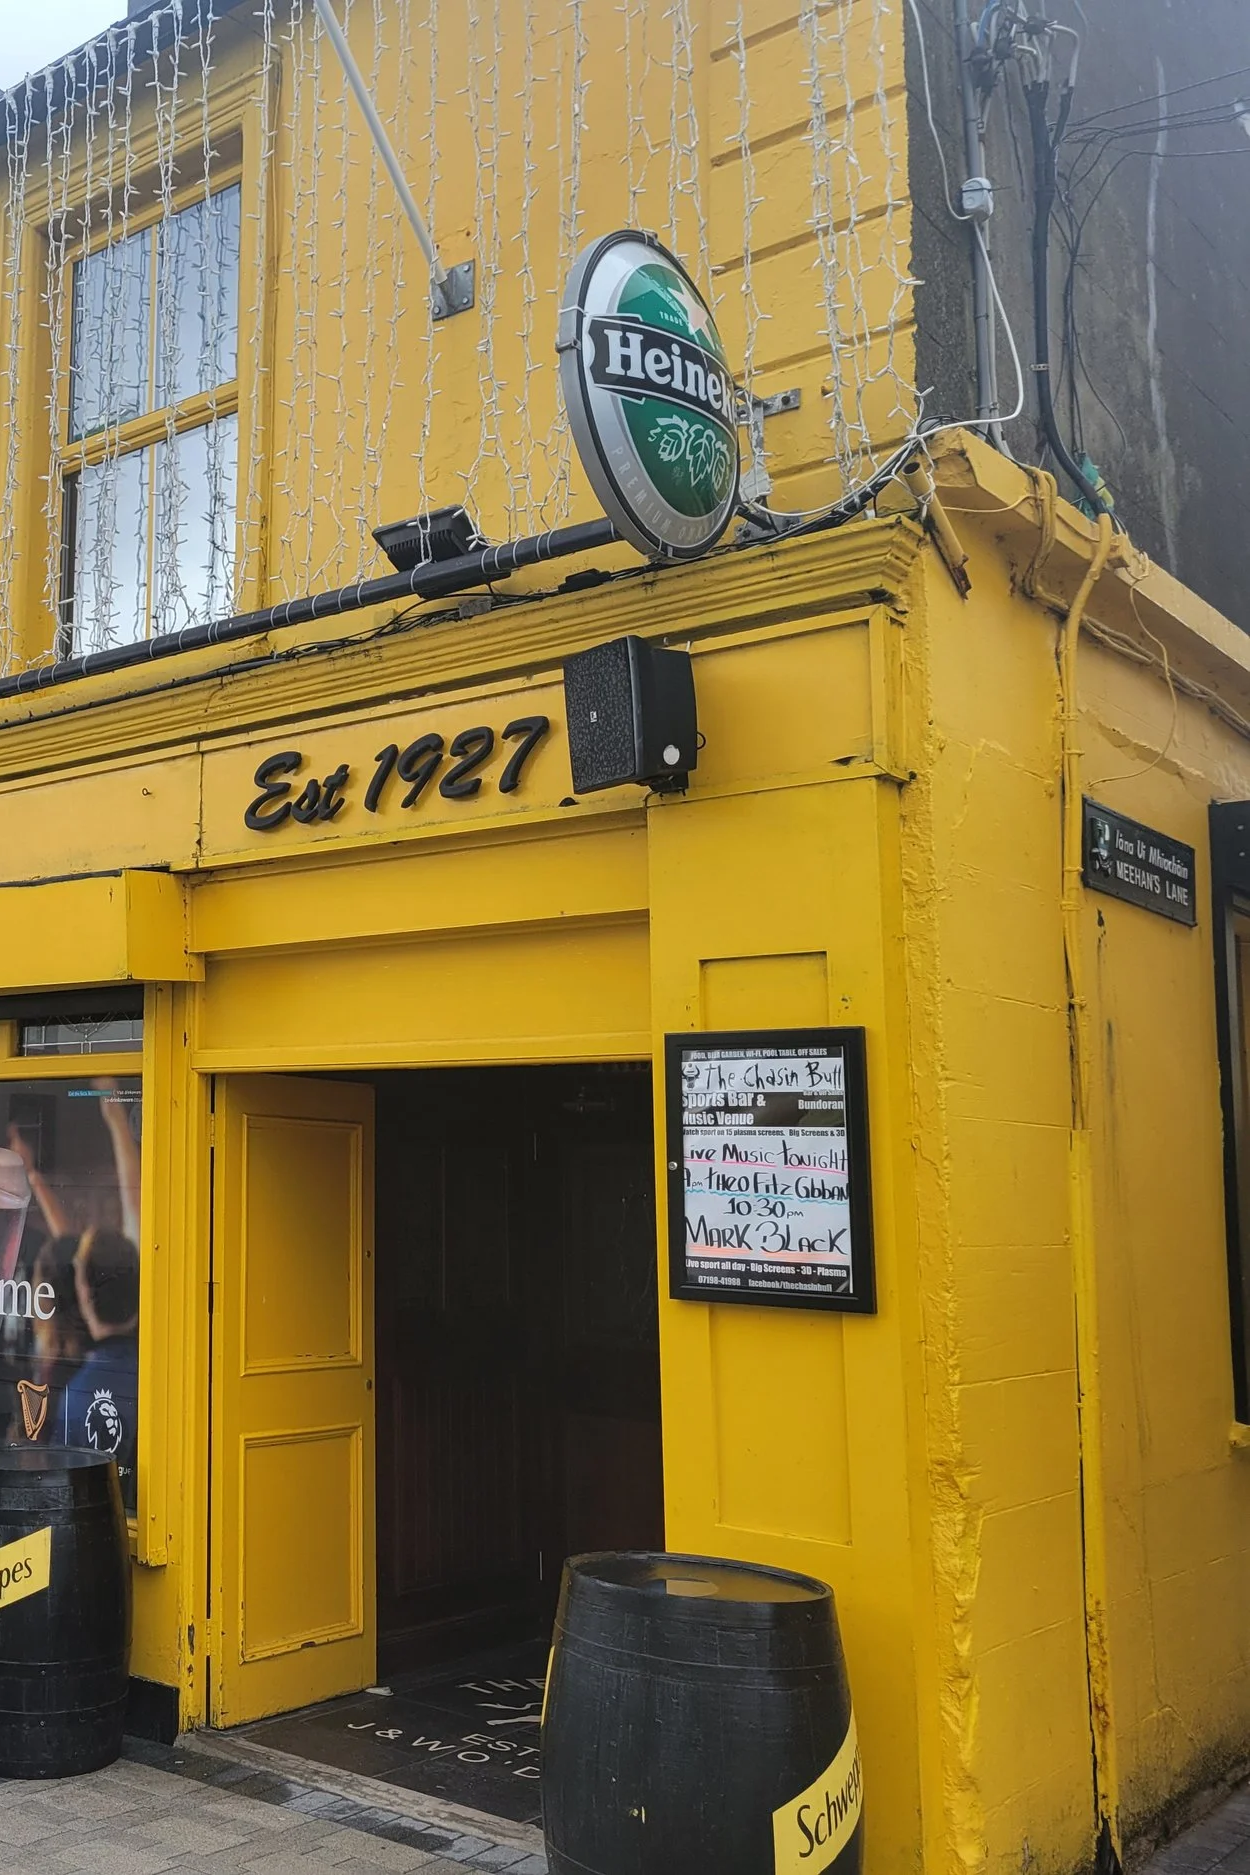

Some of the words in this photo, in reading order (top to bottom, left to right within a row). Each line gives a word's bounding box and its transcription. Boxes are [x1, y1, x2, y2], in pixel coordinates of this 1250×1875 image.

[603, 329, 733, 423] Heinek
[244, 750, 350, 831] Est
[363, 715, 550, 813] 1927
[1116, 860, 1161, 894] MEEHAN'S
[1166, 880, 1188, 906] LANE
[809, 1048, 827, 1056] SALES
[705, 1063, 736, 1090] The
[743, 1063, 799, 1090] Chasin
[804, 1061, 842, 1090] Bull
[682, 1091, 725, 1109] Sports
[727, 1091, 754, 1107] Bar
[757, 1094, 766, 1107] &
[798, 1099, 844, 1110] Bundoran
[716, 1111, 754, 1125] Venue
[700, 1130, 716, 1138] sport
[733, 1129, 756, 1138] plasma
[789, 1129, 800, 1138] Big
[801, 1129, 829, 1137] Screens
[836, 1129, 845, 1137] 3D
[700, 1261, 720, 1271] sport
[721, 1261, 731, 1270] all
[732, 1262, 745, 1272] day
[751, 1263, 763, 1274] Big
[763, 1265, 795, 1275] Screens
[801, 1266, 812, 1275] 3D
[817, 1267, 847, 1277] Plasma
[458, 1678, 546, 1694] THE
[375, 1728, 403, 1740] &
